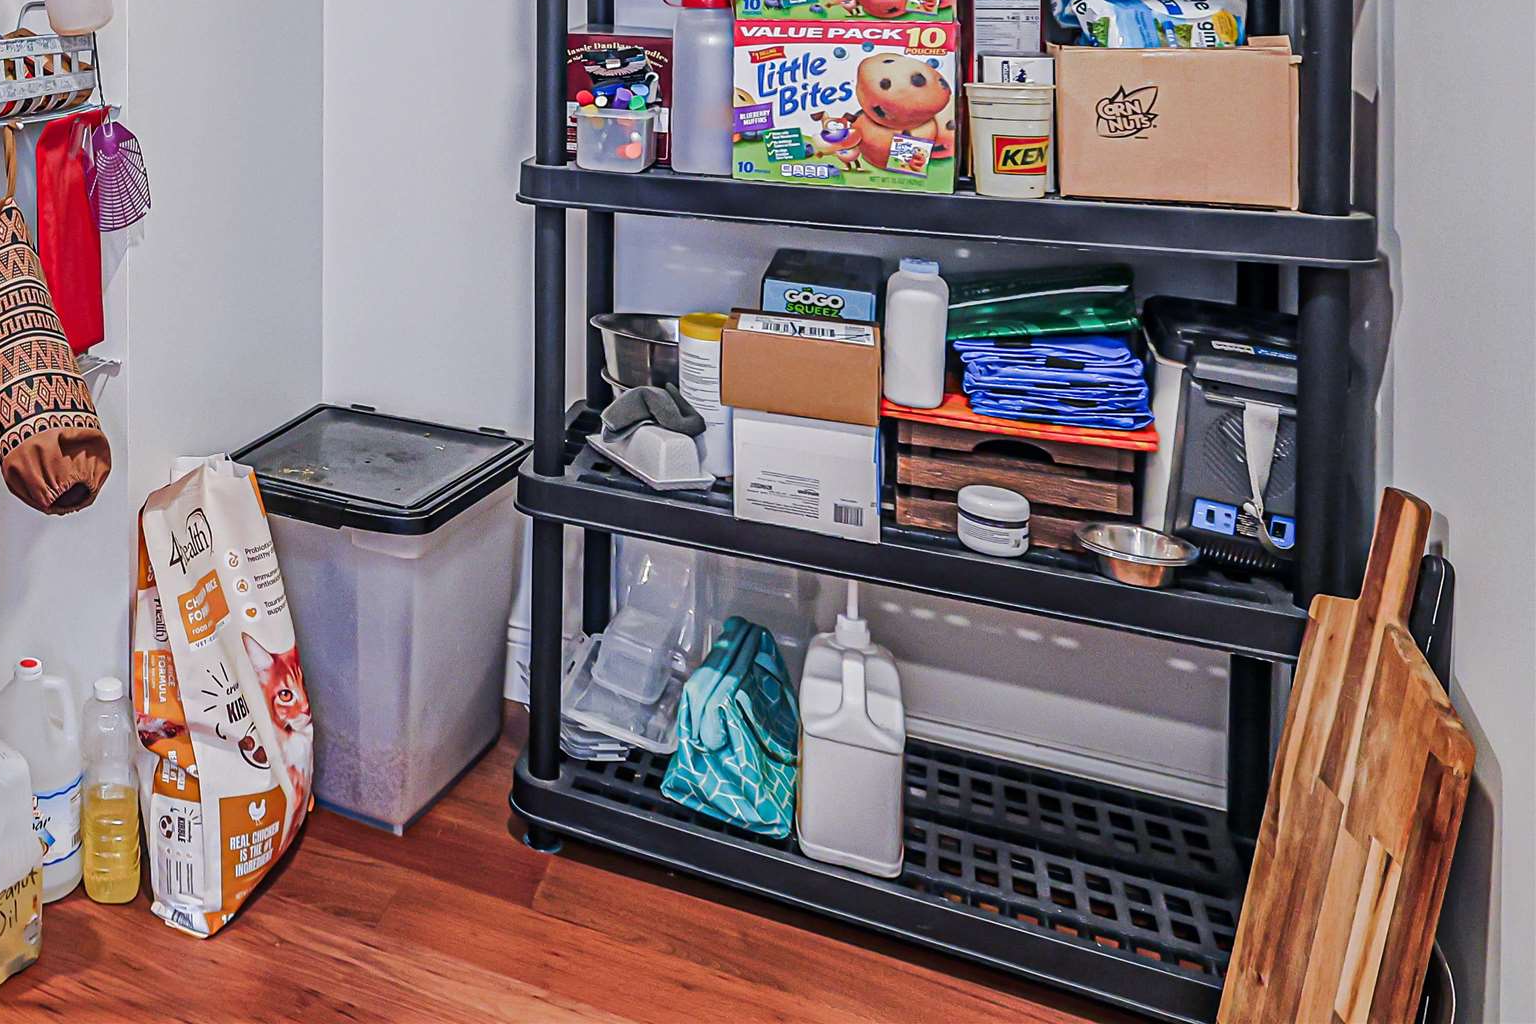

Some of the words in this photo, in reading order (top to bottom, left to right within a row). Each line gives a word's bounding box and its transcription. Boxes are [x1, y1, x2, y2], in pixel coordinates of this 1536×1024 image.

[740, 26, 823, 39] VALUE
[827, 27, 904, 40] PACK
[905, 27, 948, 49] 10
[567, 44, 593, 56] lassic
[904, 47, 948, 56] POUCHES
[757, 52, 827, 97] Little
[780, 82, 853, 117] Bites
[1095, 98, 1143, 120] CORN
[739, 110, 771, 119] BLUEBERRY
[743, 117, 768, 126] MUFFINS
[1107, 114, 1152, 133] NUTS
[738, 162, 754, 173] 10
[784, 288, 845, 309] GOGO
[786, 303, 841, 317] SQUEEZ
[159, 655, 167, 703] FORMULA
[230, 833, 250, 850] REAL
[252, 821, 280, 844] CHICKEN
[240, 849, 247, 862] IS
[250, 844, 262, 858] THE
[235, 848, 273, 878] INGREDIENT
